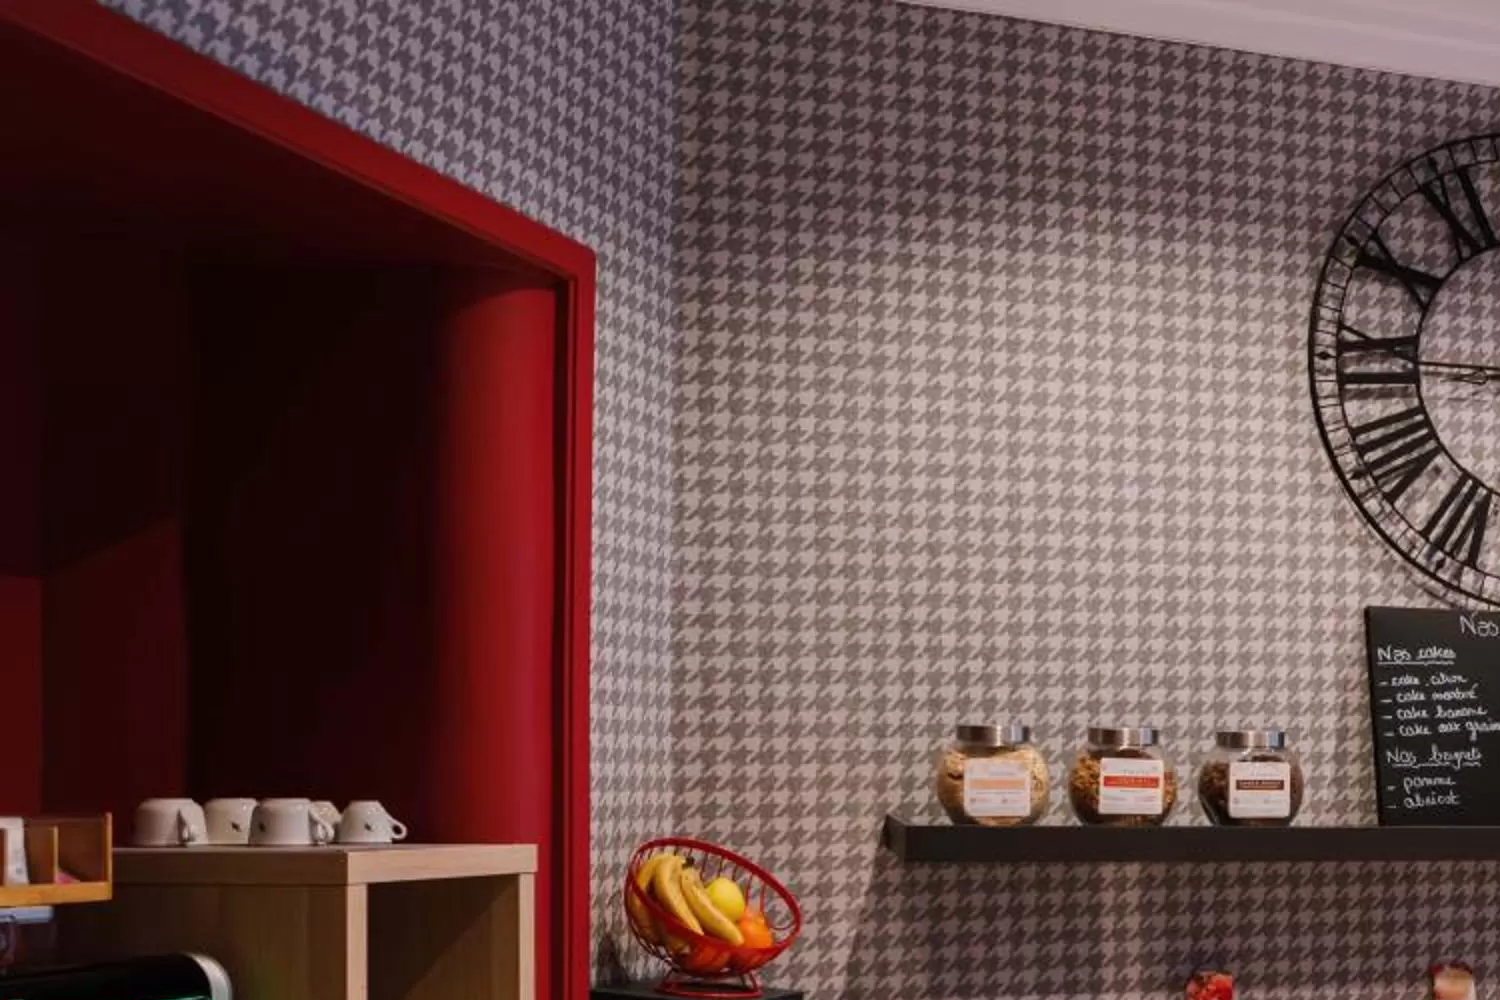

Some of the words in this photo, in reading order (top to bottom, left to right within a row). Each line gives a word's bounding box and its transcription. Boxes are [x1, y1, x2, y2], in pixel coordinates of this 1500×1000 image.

[1460, 611, 1499, 637] Nos
[1377, 644, 1411, 661] Nos
[1386, 746, 1418, 766] Nos
